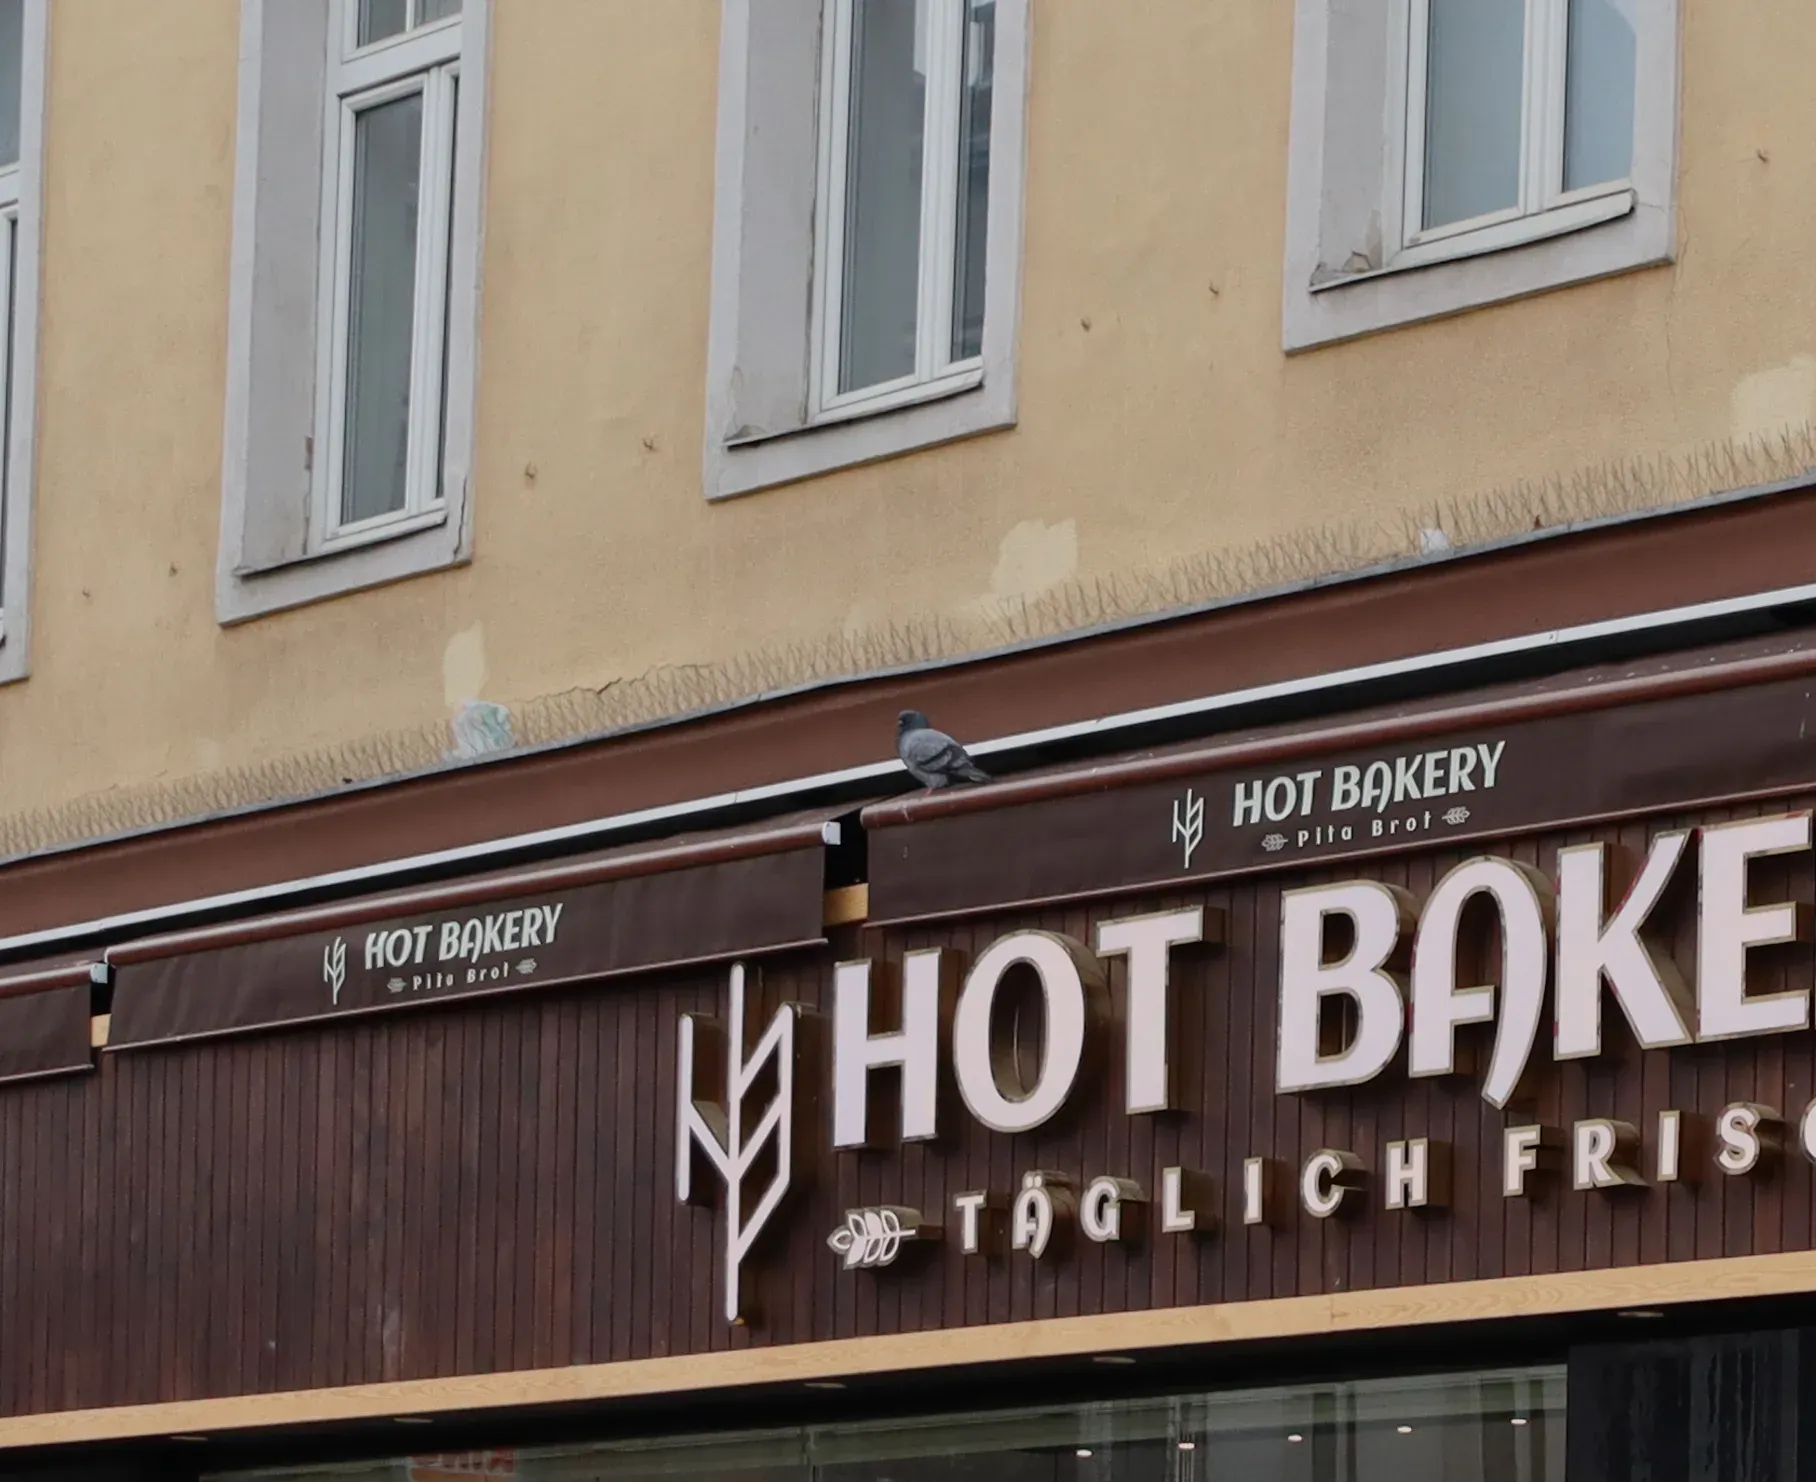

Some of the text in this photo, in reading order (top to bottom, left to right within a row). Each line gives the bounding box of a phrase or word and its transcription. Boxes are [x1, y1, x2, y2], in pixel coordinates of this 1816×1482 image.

[1232, 740, 1506, 827] HOT BAKERY
[1297, 810, 1432, 847] Pita Brot
[364, 902, 564, 970] HOT BAKERY
[412, 961, 509, 991] Pita Brot
[832, 905, 1204, 1150] HOT
[953, 1137, 1430, 1260] TÄGLICH
